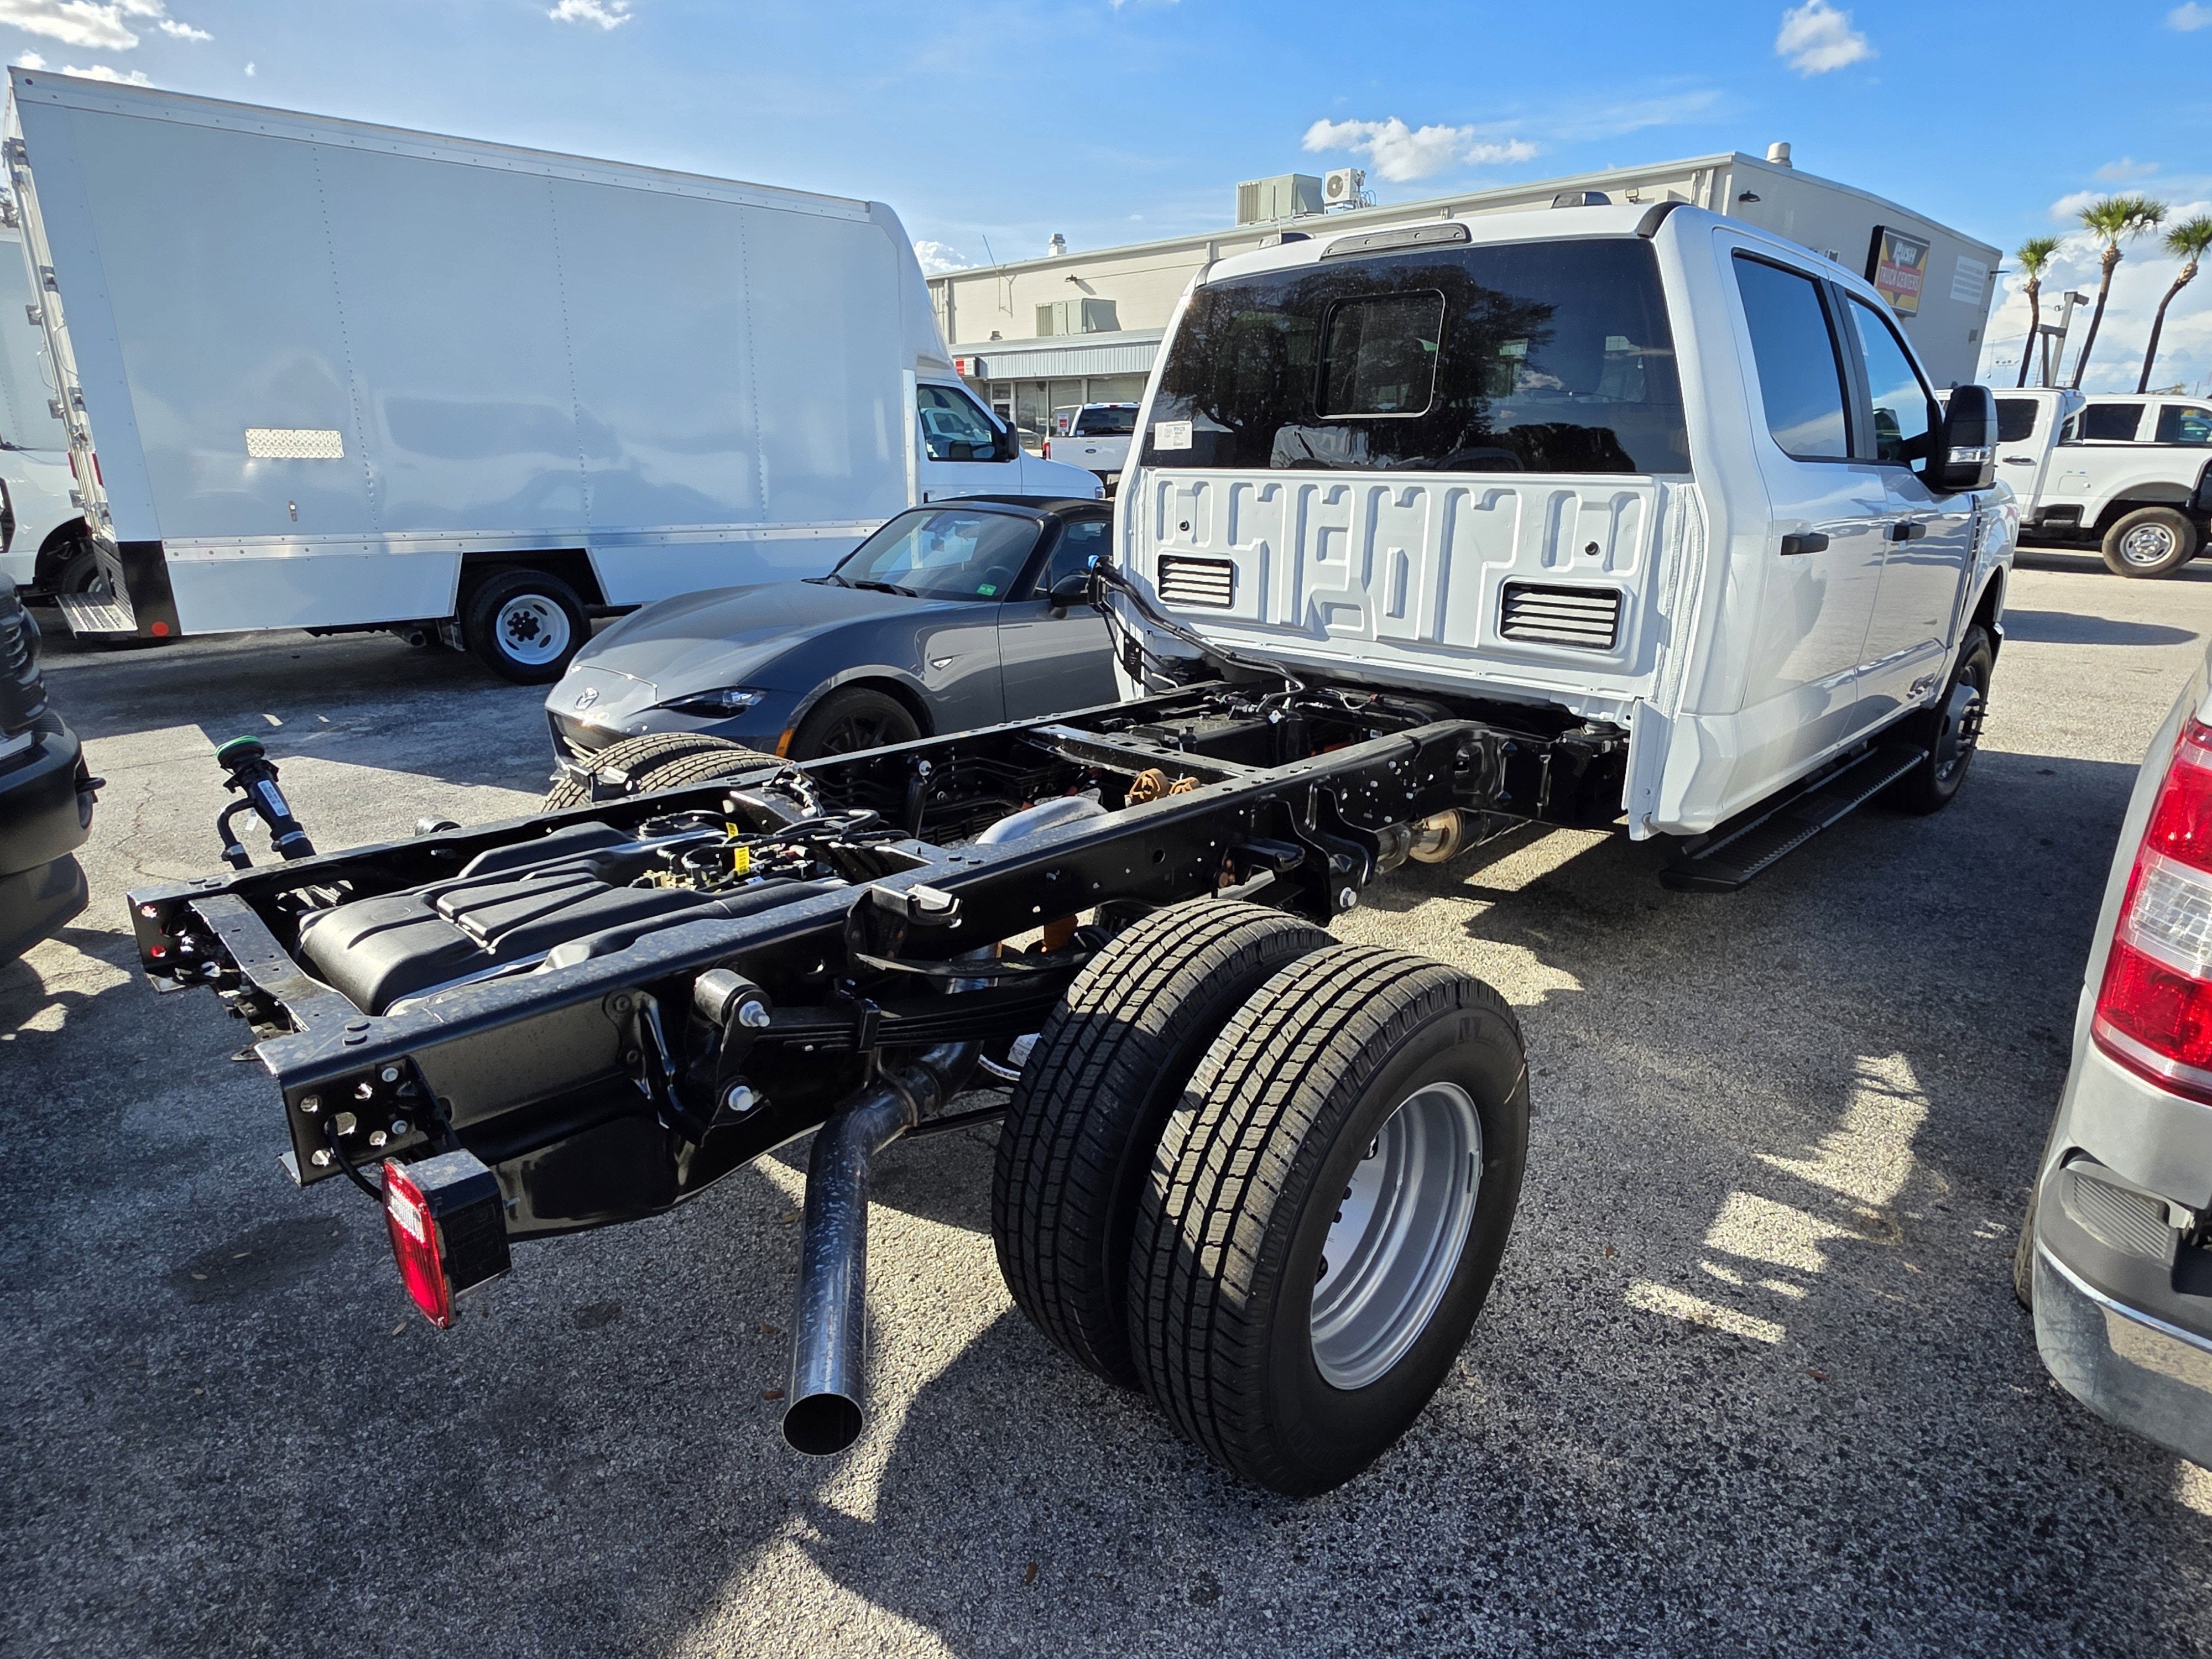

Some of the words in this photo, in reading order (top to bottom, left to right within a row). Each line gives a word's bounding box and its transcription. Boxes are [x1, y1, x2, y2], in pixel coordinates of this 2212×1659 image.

[1892, 239, 1917, 267] RUSH
[1880, 265, 1897, 286] TRUCK
[1897, 270, 1921, 291] CENTERS
